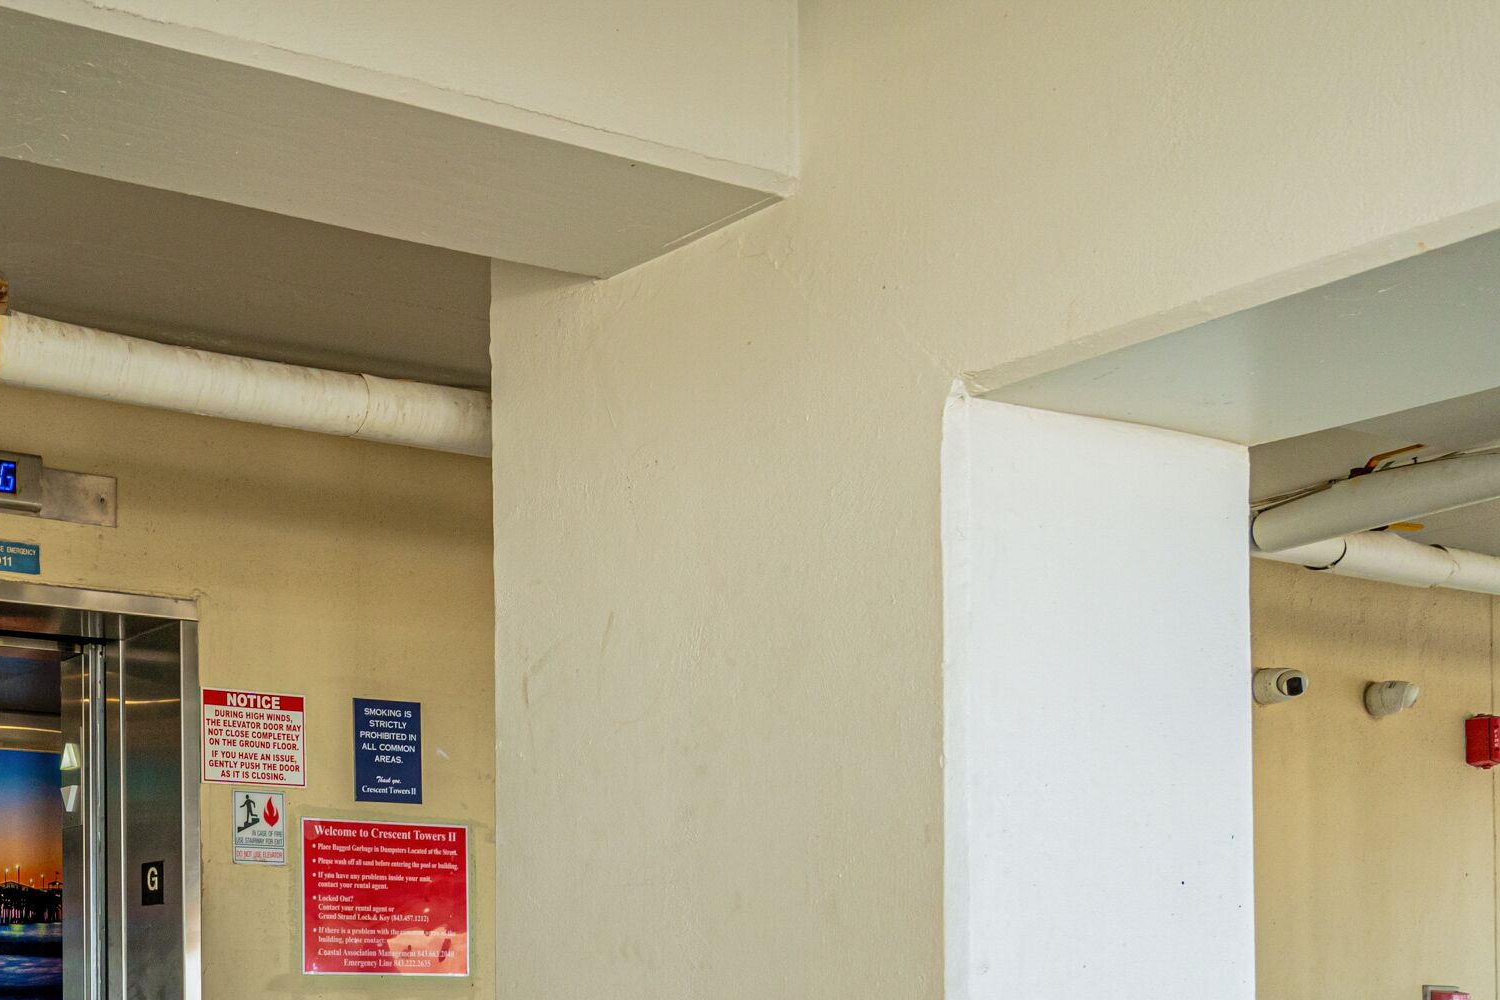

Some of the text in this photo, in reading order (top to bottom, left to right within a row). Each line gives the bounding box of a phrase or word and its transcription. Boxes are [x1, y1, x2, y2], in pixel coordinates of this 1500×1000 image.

[0, 463, 14, 491] G
[7, 546, 36, 556] EMERGENCY
[227, 693, 280, 709] NOTICE
[215, 710, 292, 723] DURING HIGH WINDS,
[364, 708, 402, 717] SMOKING
[223, 720, 260, 729] ELEVATOR
[263, 723, 284, 731] DOOR
[369, 720, 407, 729] STRICTLY
[208, 728, 299, 742] NOT CLOSE COMPLETELY
[360, 731, 407, 741] PROHIBITED
[222, 738, 236, 746] THE
[239, 740, 270, 749] GROUND
[273, 742, 299, 750] FLOOR.
[379, 744, 415, 752] COMMON
[221, 751, 236, 759] YOU
[238, 752, 258, 760] HAVE
[273, 754, 297, 763] ISSUE,
[374, 755, 403, 764] AREAS.
[209, 760, 300, 772] GENTLY PUSH THE DOOR
[242, 771, 249, 779] IS
[252, 772, 286, 781] CLOSING.
[362, 785, 388, 794] Crescent
[314, 825, 456, 842] Welcome to Crescent Towers II
[332, 844, 351, 852] Bagged
[352, 845, 373, 853] Garbage
[380, 846, 407, 855] Dumpsters
[318, 857, 333, 865] Please
[391, 861, 411, 869] entering
[147, 867, 158, 891] G
[318, 894, 338, 902] Locked
[318, 912, 336, 920] Grand
[318, 948, 341, 956] Coastal
[344, 959, 377, 968] Emergency
